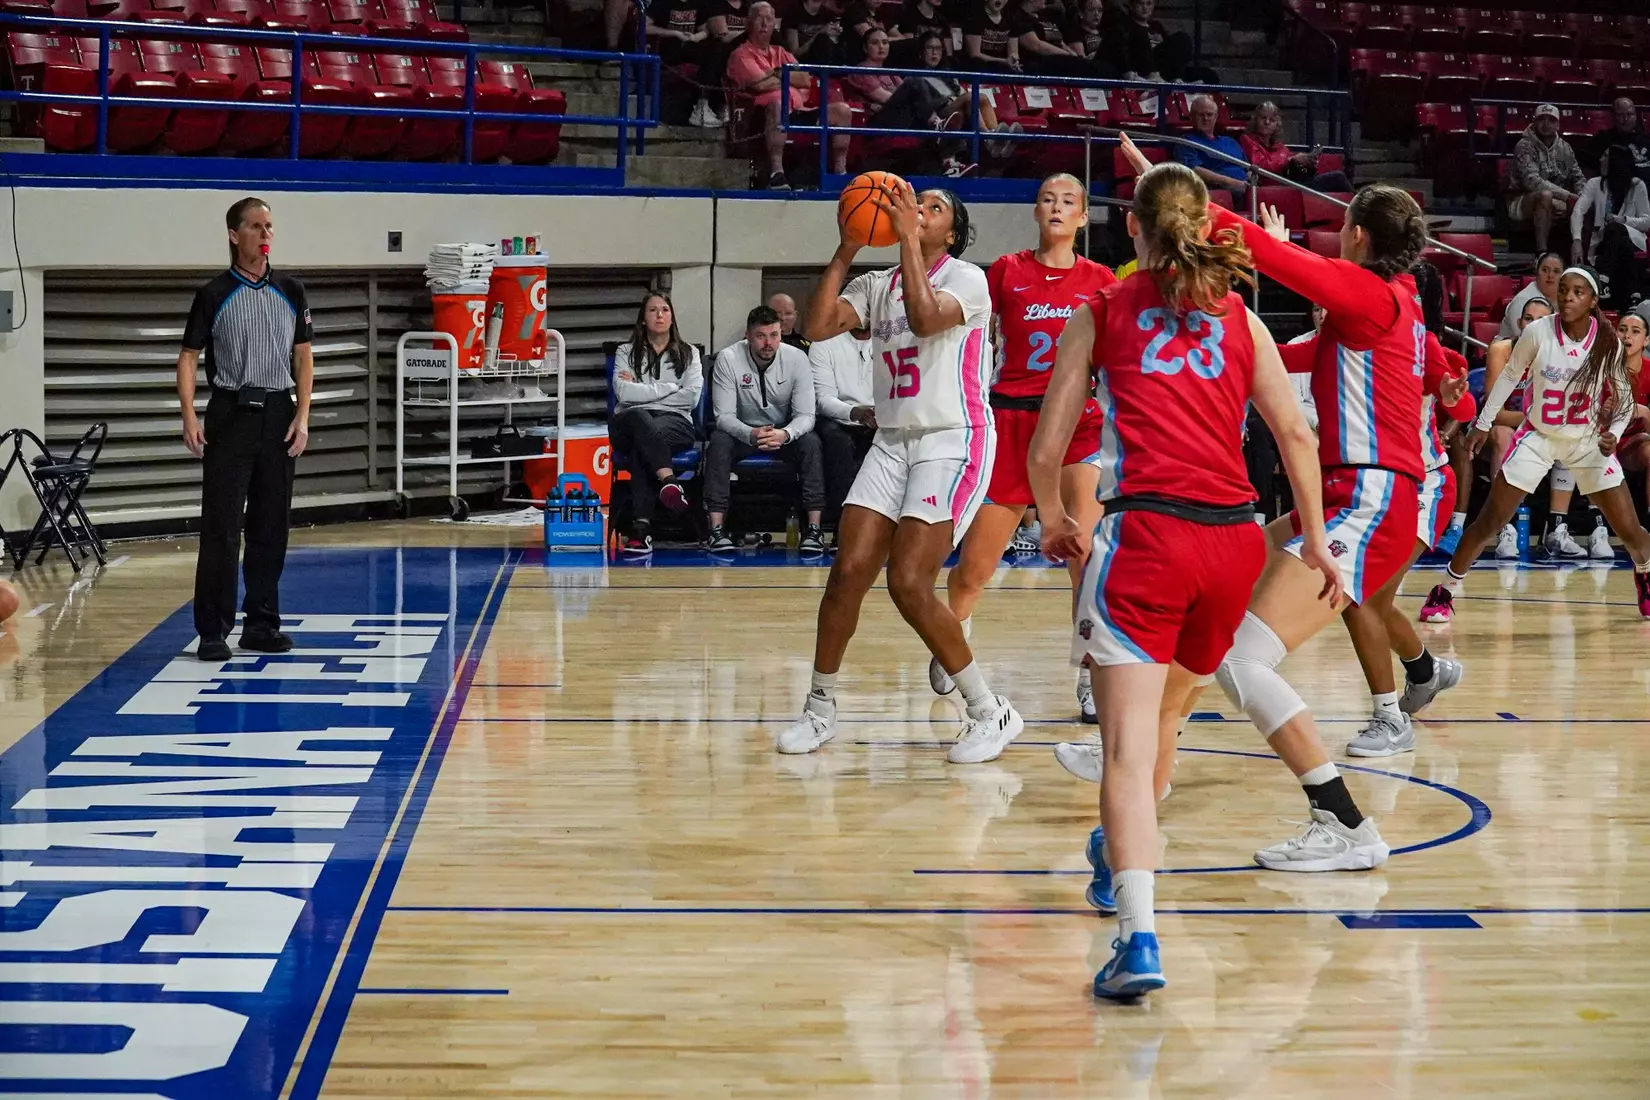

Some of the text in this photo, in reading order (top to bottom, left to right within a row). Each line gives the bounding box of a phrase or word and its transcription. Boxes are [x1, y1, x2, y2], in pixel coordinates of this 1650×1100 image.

[20, 75, 34, 91] T
[530, 280, 546, 312] G
[1026, 331, 1064, 372] 2
[1136, 307, 1226, 380] 23
[406, 358, 447, 368] GATORADE
[881, 345, 921, 400] 15
[1541, 389, 1591, 426] 22
[592, 445, 610, 476] G
[114, 612, 449, 714] TECH
